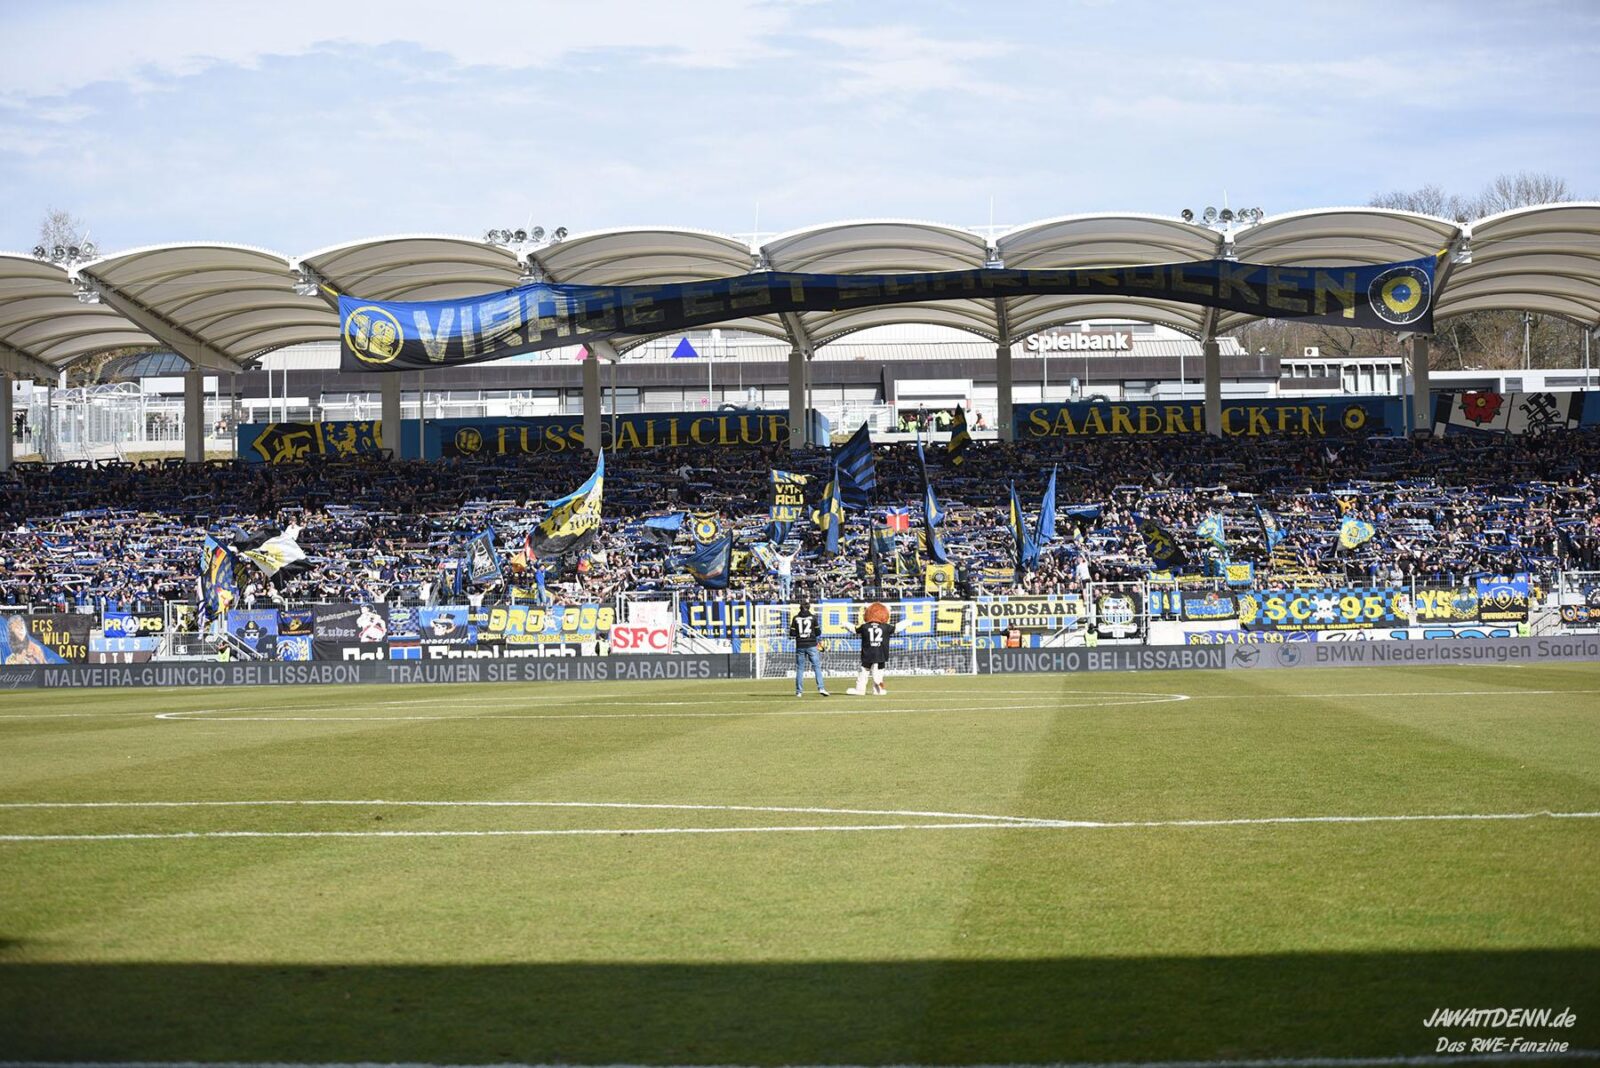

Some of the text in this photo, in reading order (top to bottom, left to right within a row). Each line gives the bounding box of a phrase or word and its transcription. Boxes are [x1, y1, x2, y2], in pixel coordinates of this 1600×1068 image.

[412, 285, 665, 362] VIRAGE
[681, 274, 817, 318] EST
[1026, 333, 1129, 352] Spielbank
[690, 604, 781, 626] CLIQUE
[976, 602, 1078, 617] NORDSAAR
[1265, 596, 1384, 620] SC 95
[1481, 611, 1527, 620] SAARBRÜCKE
[32, 619, 53, 632] FCS
[139, 617, 163, 631] FCS
[796, 618, 812, 634] 12
[43, 632, 70, 645] WILD
[613, 626, 668, 650] SFC
[868, 627, 884, 642] 12
[1216, 632, 1259, 644] SARG
[59, 645, 87, 659] CATS
[1088, 650, 1118, 671] BEI
[1125, 649, 1222, 671] LISSABON
[1316, 645, 1365, 662] BMW
[1372, 642, 1531, 661] Niederlassungen
[44, 666, 226, 687] MALVEIRA-GUINCHO
[236, 666, 266, 685] BEI
[269, 664, 360, 684] LISSABON
[387, 661, 480, 682] TRÄUMEN
[487, 664, 517, 682] SIE
[524, 663, 569, 681] SICH
[577, 662, 608, 680] INS
[616, 660, 710, 679] PARADIES
